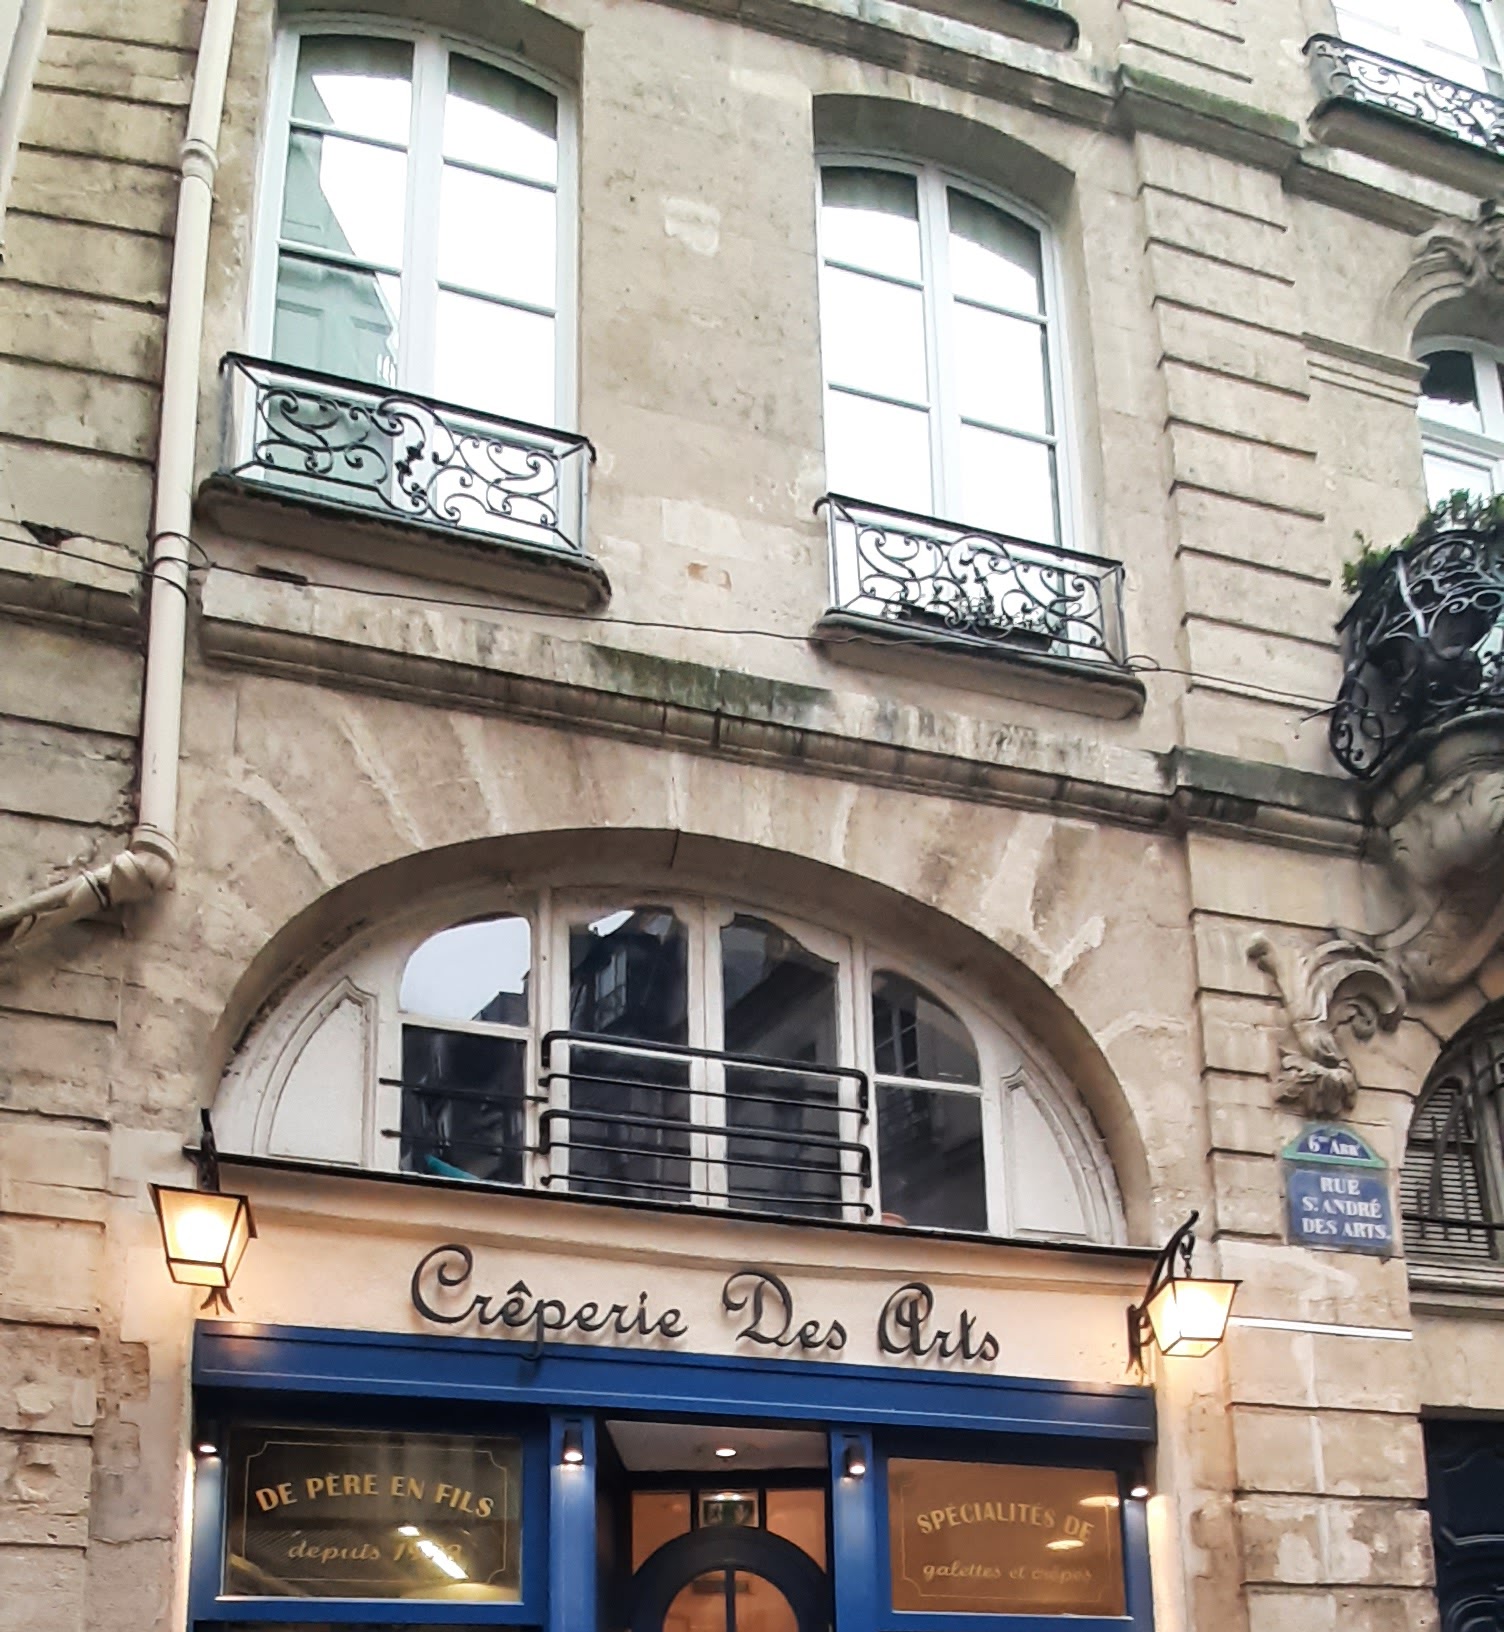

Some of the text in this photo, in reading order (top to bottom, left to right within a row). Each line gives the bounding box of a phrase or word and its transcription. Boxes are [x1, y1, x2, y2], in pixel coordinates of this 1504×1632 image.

[1320, 1176, 1361, 1196] RUE
[1322, 1197, 1383, 1219] ANDRÉ
[1301, 1217, 1339, 1235] DES
[411, 1244, 998, 1362] Crêperie Des Arts
[255, 1472, 495, 1518] DE PÈRE EN FILS
[916, 1501, 1096, 1542] SPÉCIALITÉS DE
[287, 1540, 383, 1565] depuis
[922, 1559, 1002, 1582] galettes
